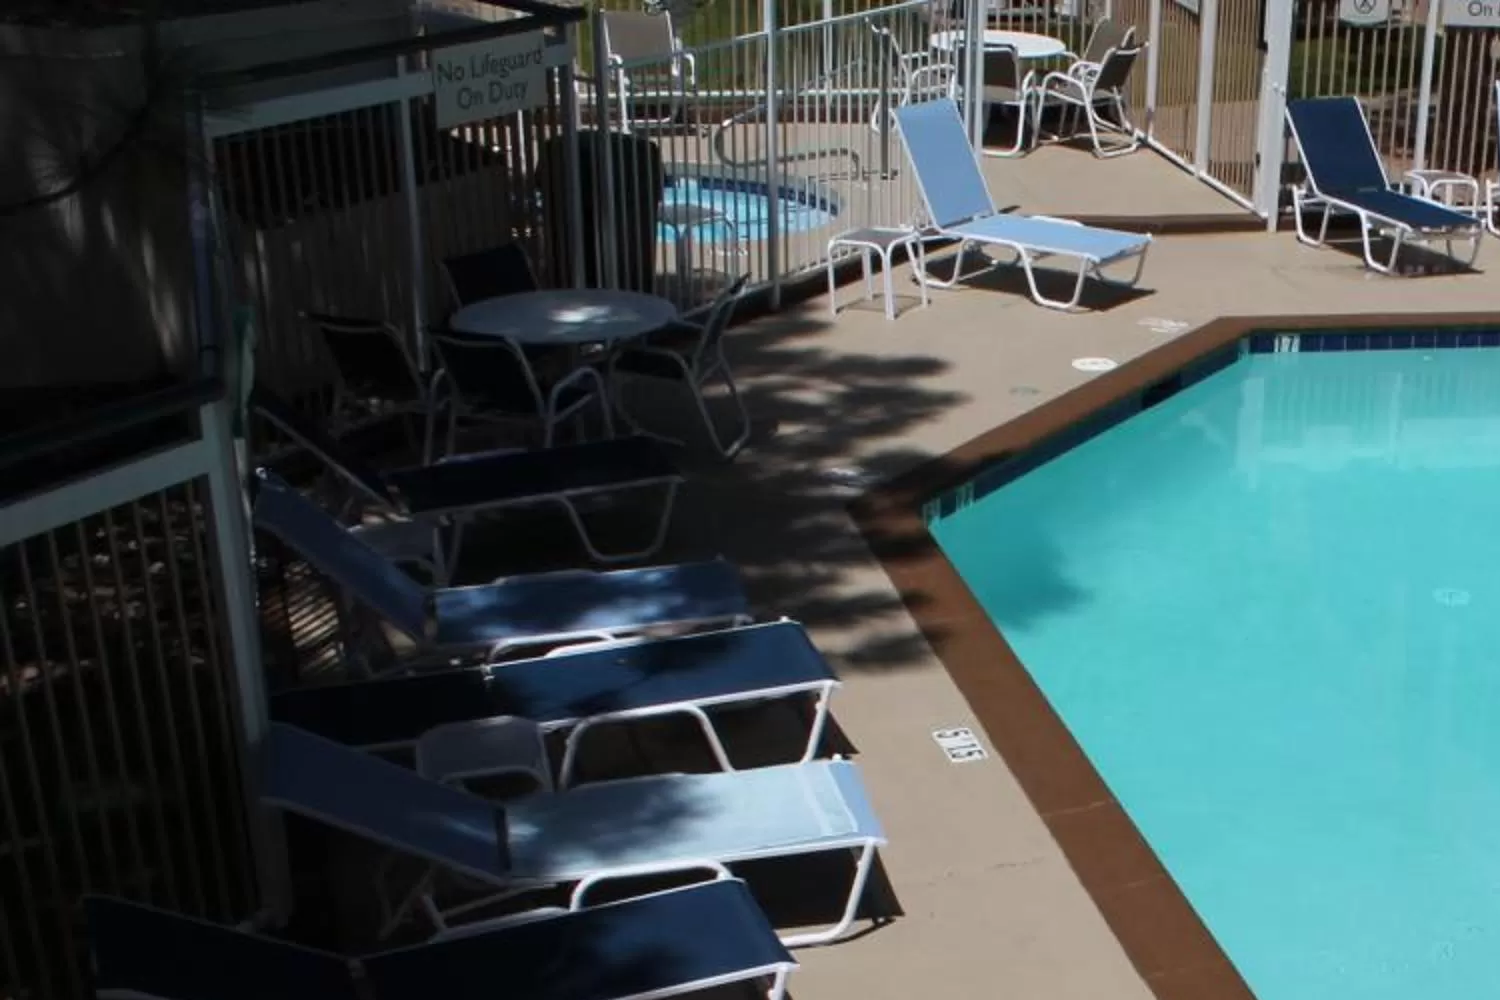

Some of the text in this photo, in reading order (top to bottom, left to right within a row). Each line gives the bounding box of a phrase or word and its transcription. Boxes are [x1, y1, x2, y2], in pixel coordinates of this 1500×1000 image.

[1467, 1, 1493, 17] On
[437, 47, 543, 84] No Lifeguard
[457, 80, 528, 109] On Duty
